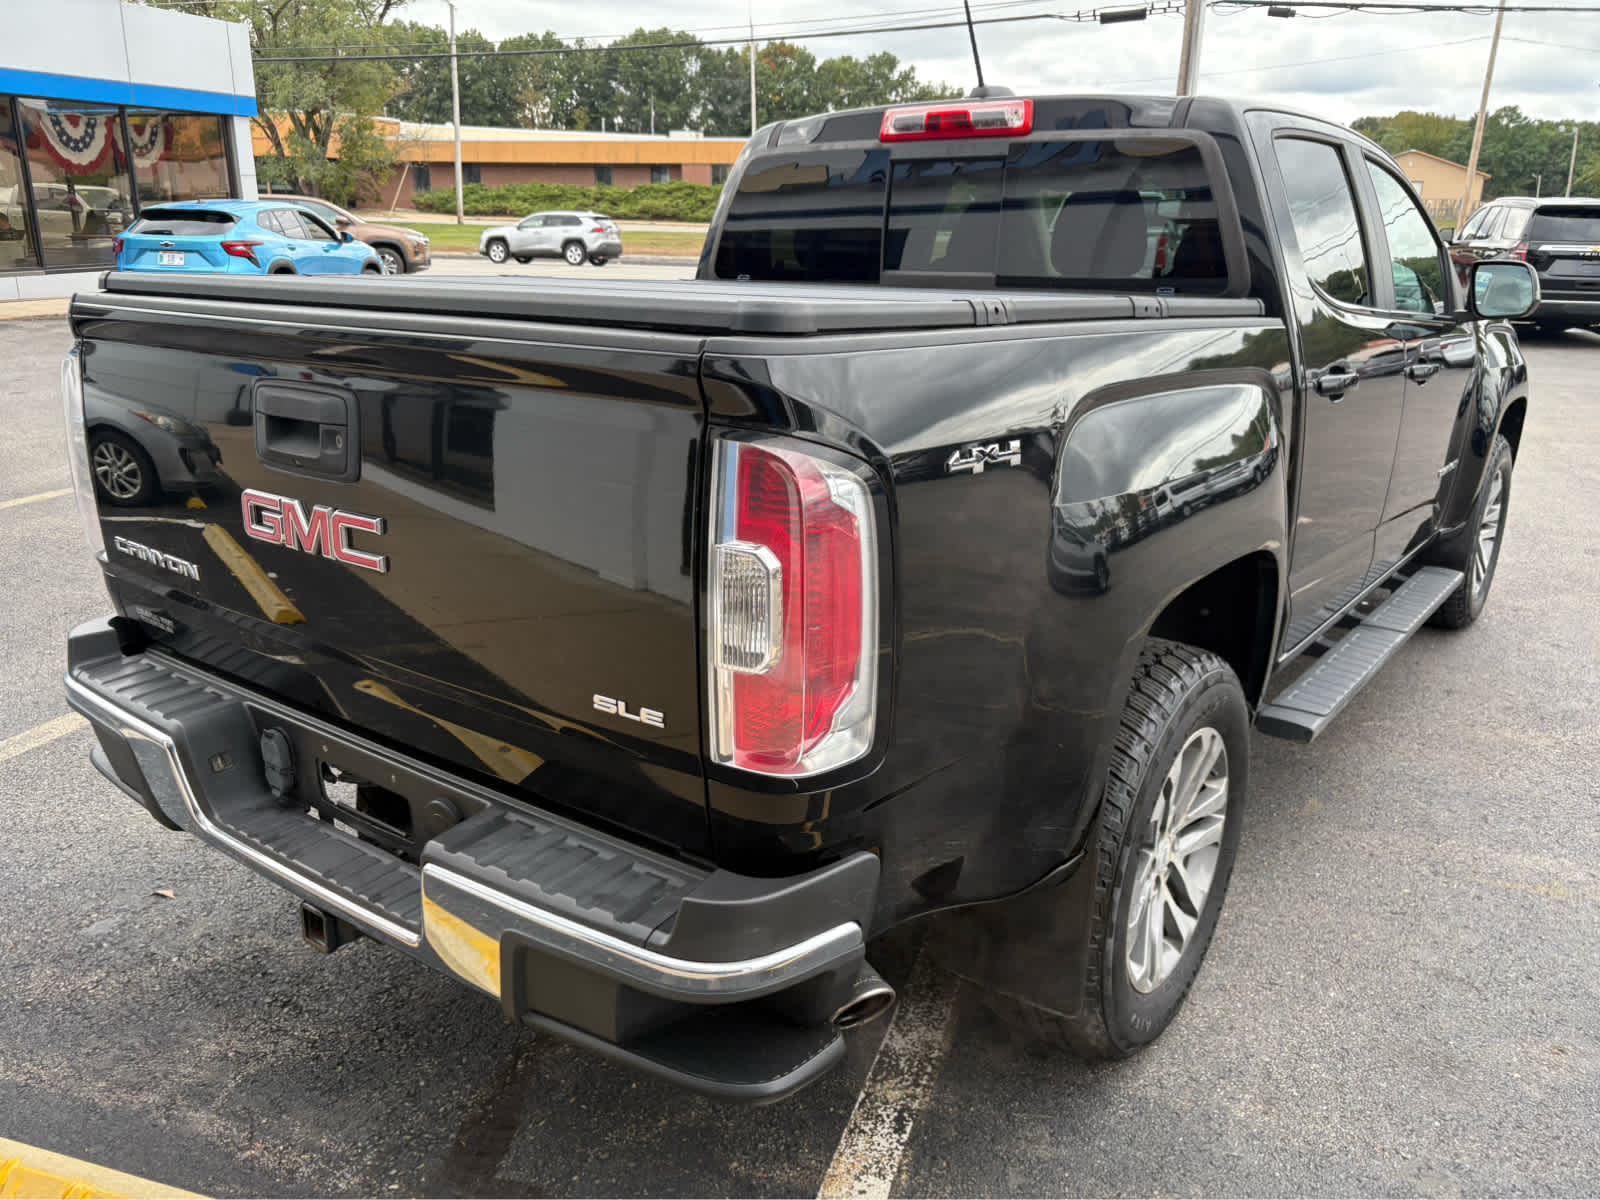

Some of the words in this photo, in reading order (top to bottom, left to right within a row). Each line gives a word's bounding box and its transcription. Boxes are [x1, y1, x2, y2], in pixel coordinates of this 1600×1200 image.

[242, 488, 387, 572] GMC
[114, 535, 200, 581] CANYON
[593, 694, 664, 728] SLE
